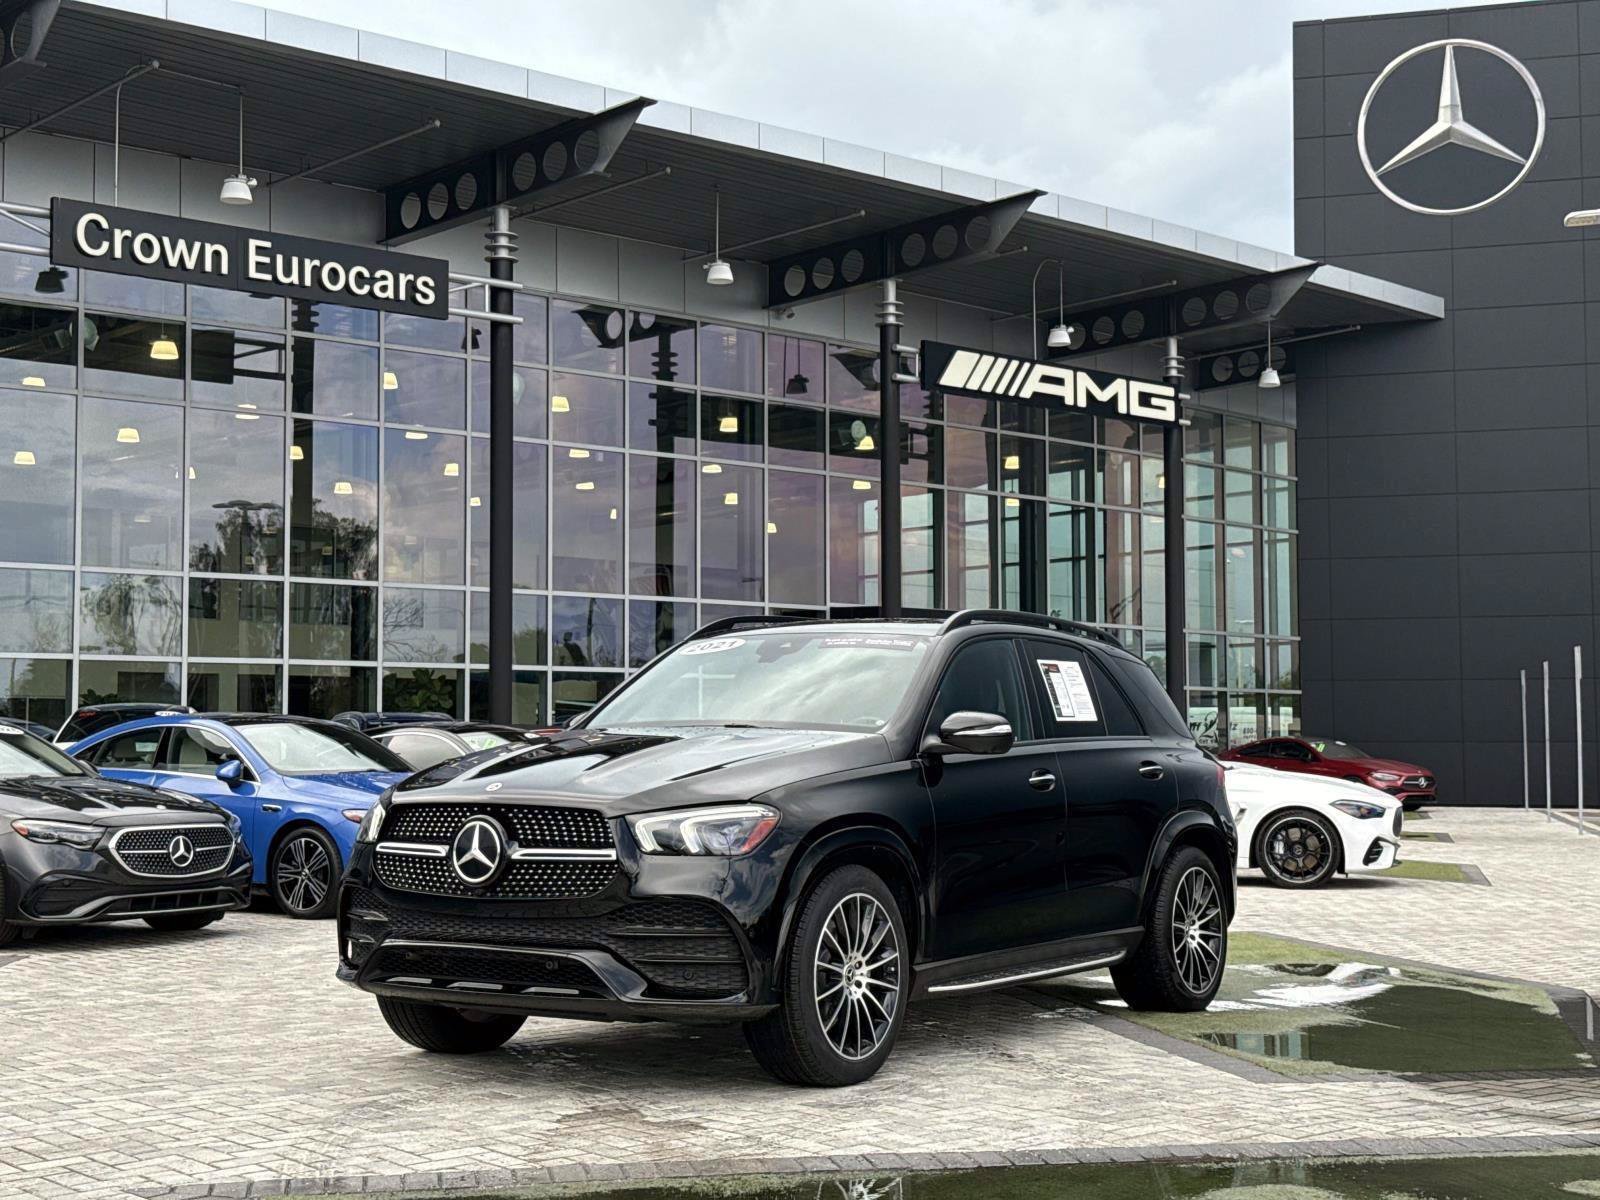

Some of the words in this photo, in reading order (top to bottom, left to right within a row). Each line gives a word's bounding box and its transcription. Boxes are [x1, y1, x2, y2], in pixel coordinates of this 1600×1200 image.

[75, 212, 230, 275] Crown
[247, 237, 437, 306] Eurocars
[1018, 363, 1176, 422] AMG
[687, 640, 738, 653] 2021
